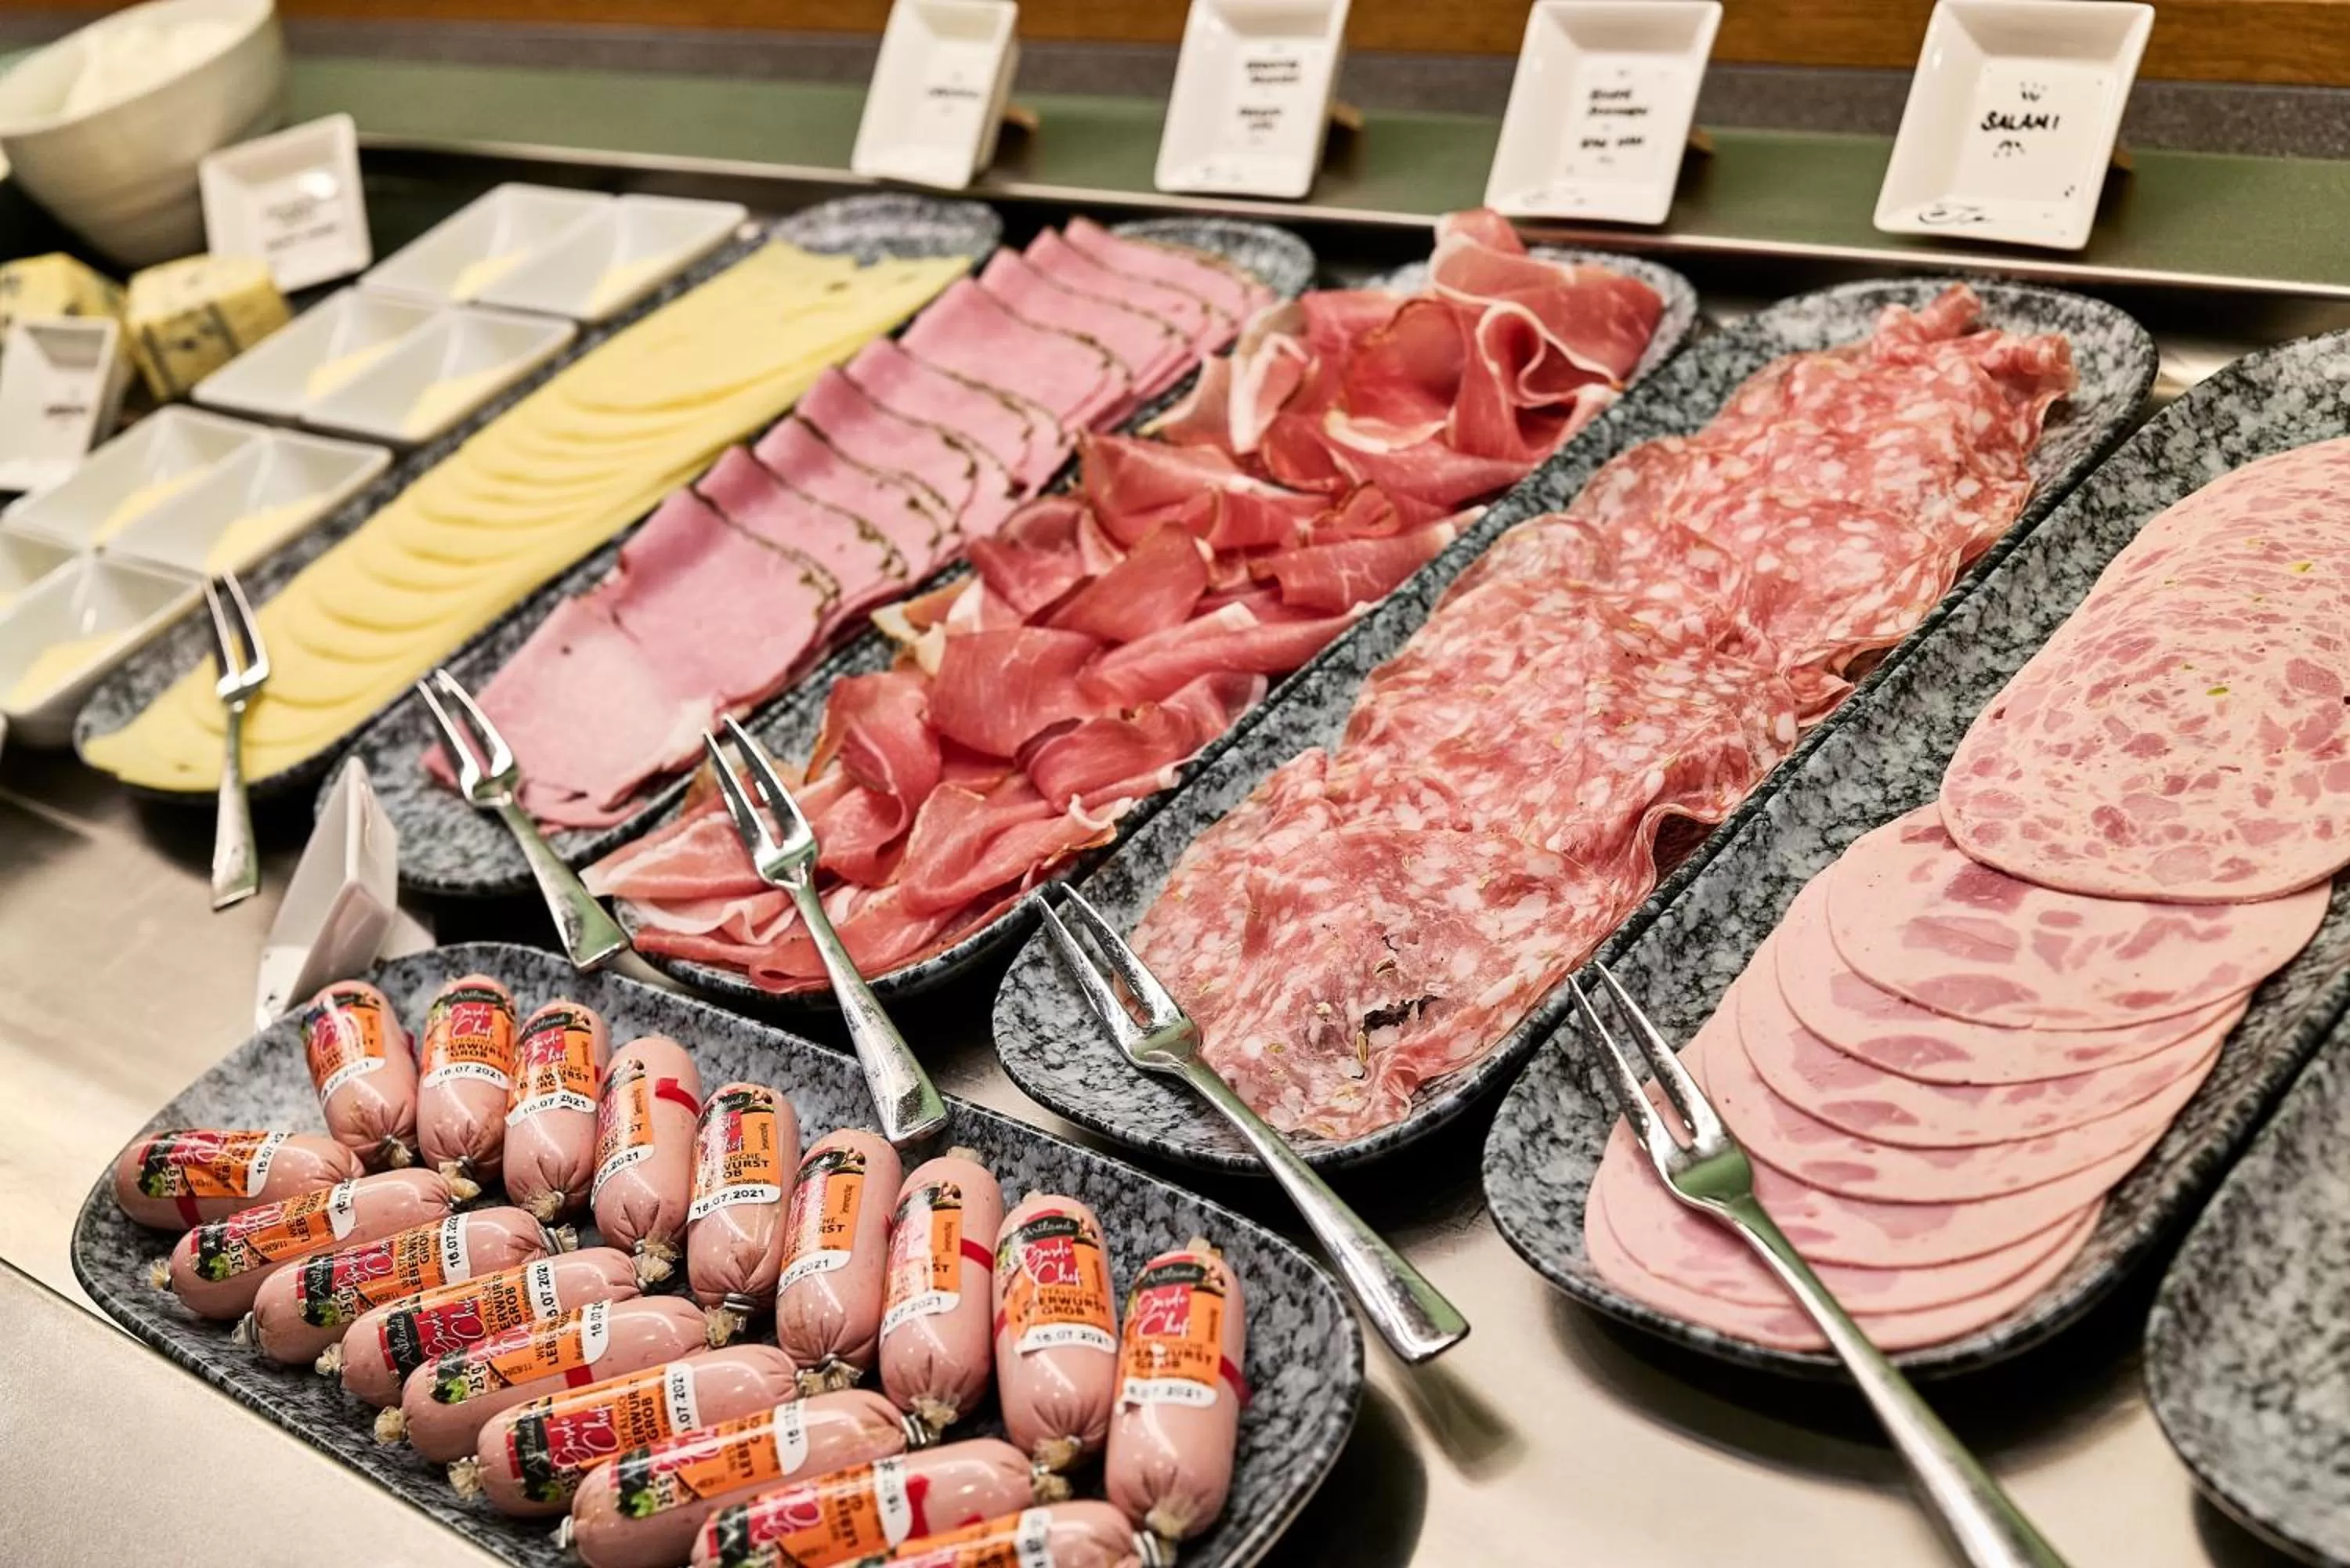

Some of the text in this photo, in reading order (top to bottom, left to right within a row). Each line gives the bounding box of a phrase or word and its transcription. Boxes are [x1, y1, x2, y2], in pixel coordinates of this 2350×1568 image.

[1980, 110, 2060, 132] SALAMI
[1021, 1220, 1074, 1236] Artland
[230, 1255, 246, 1270] 25
[1036, 1259, 1082, 1289] Chef
[451, 1295, 487, 1339] Chef
[505, 1286, 523, 1326] GROB
[1041, 1305, 1086, 1317] GROB
[394, 1313, 417, 1367] Artland
[1139, 1313, 1191, 1340] Chef
[470, 1376, 485, 1393] 25
[582, 1404, 619, 1451] Chef
[642, 1396, 660, 1441] GROB
